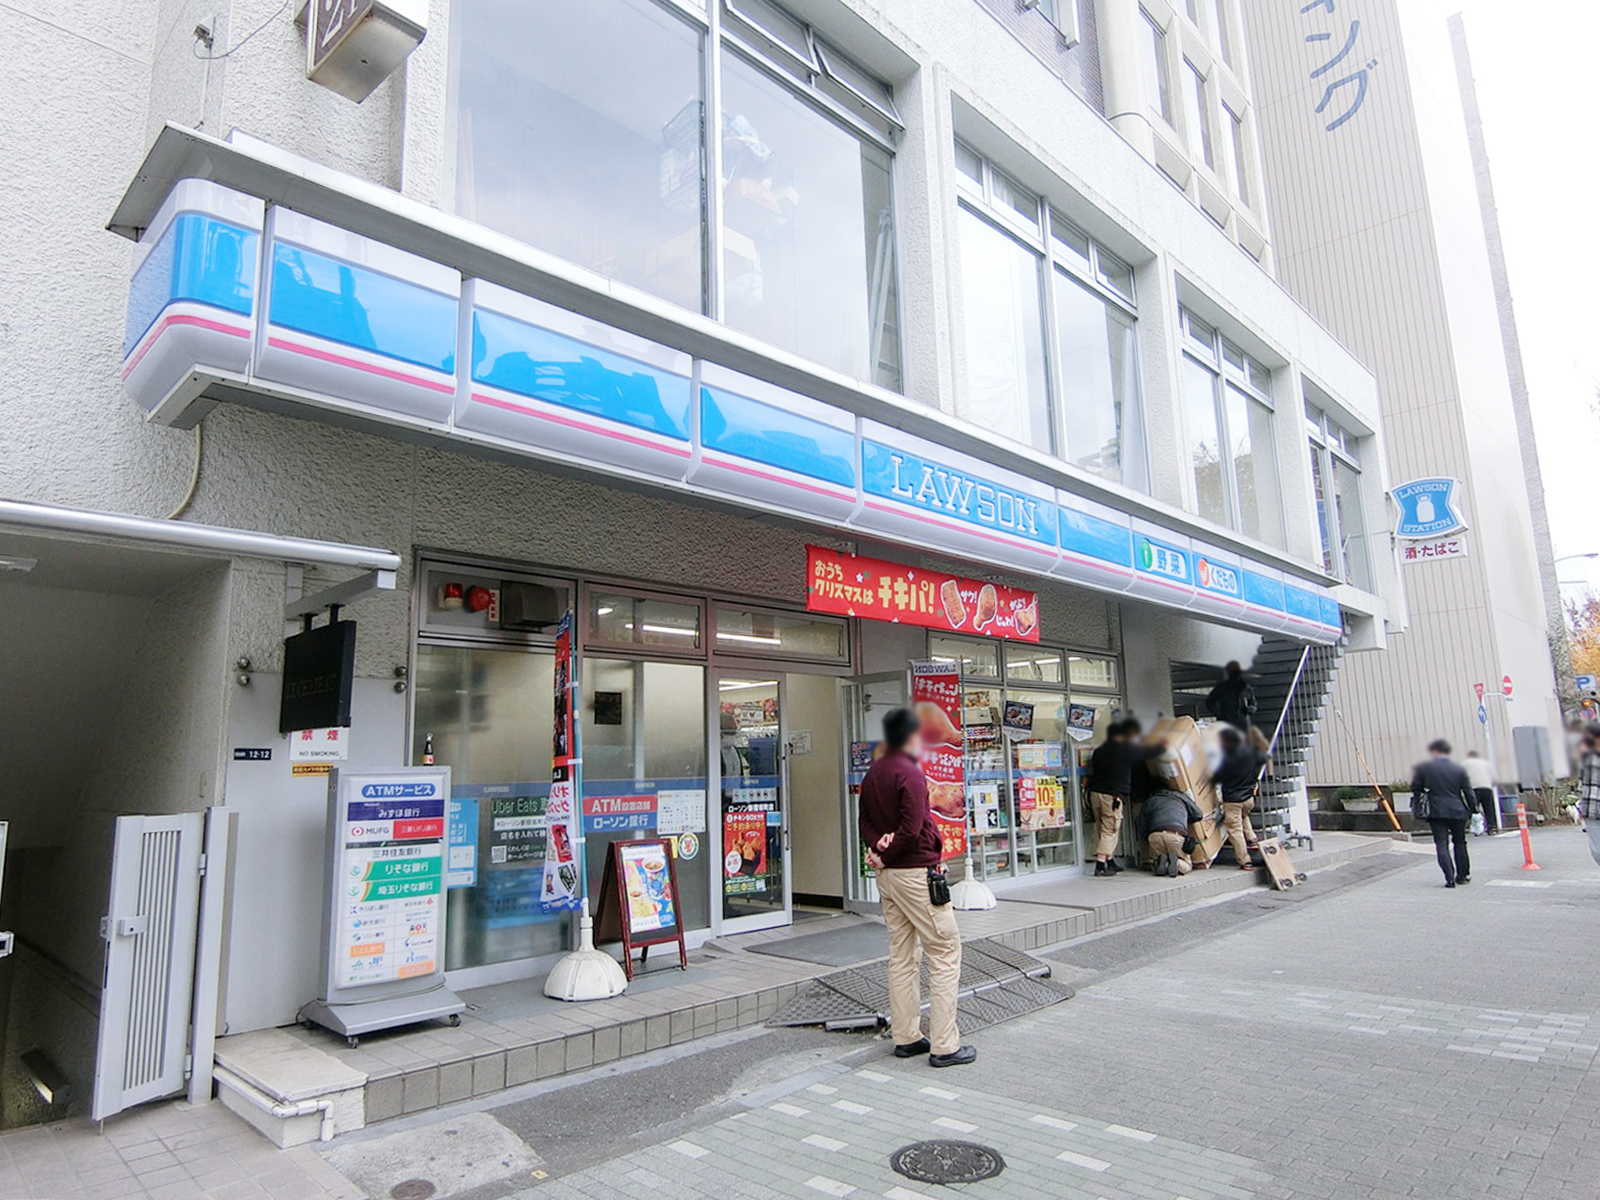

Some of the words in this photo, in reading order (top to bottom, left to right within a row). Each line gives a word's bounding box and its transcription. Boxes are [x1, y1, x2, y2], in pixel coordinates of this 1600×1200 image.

[890, 455, 1038, 535] LAWSON
[1399, 483, 1448, 499] LAWSON
[1403, 517, 1452, 533] STATION
[1405, 541, 1459, 559] 酒・たばこ
[1156, 548, 1180, 575] 野菜
[815, 560, 843, 581] おうち
[1210, 566, 1235, 591] くだもの
[815, 579, 874, 605] クリスマスは
[1576, 676, 1591, 691] P
[366, 785, 433, 796] ATMサービス
[378, 808, 421, 818] みずほ銀行
[491, 799, 514, 814] Uber
[517, 797, 538, 813] Eats
[593, 814, 649, 829] ローソン銀行
[366, 827, 390, 835] MUFG
[373, 847, 422, 859] 三井住友銀行
[385, 861, 430, 875] りそな銀行
[377, 881, 434, 895] 埼玉りそな銀行
